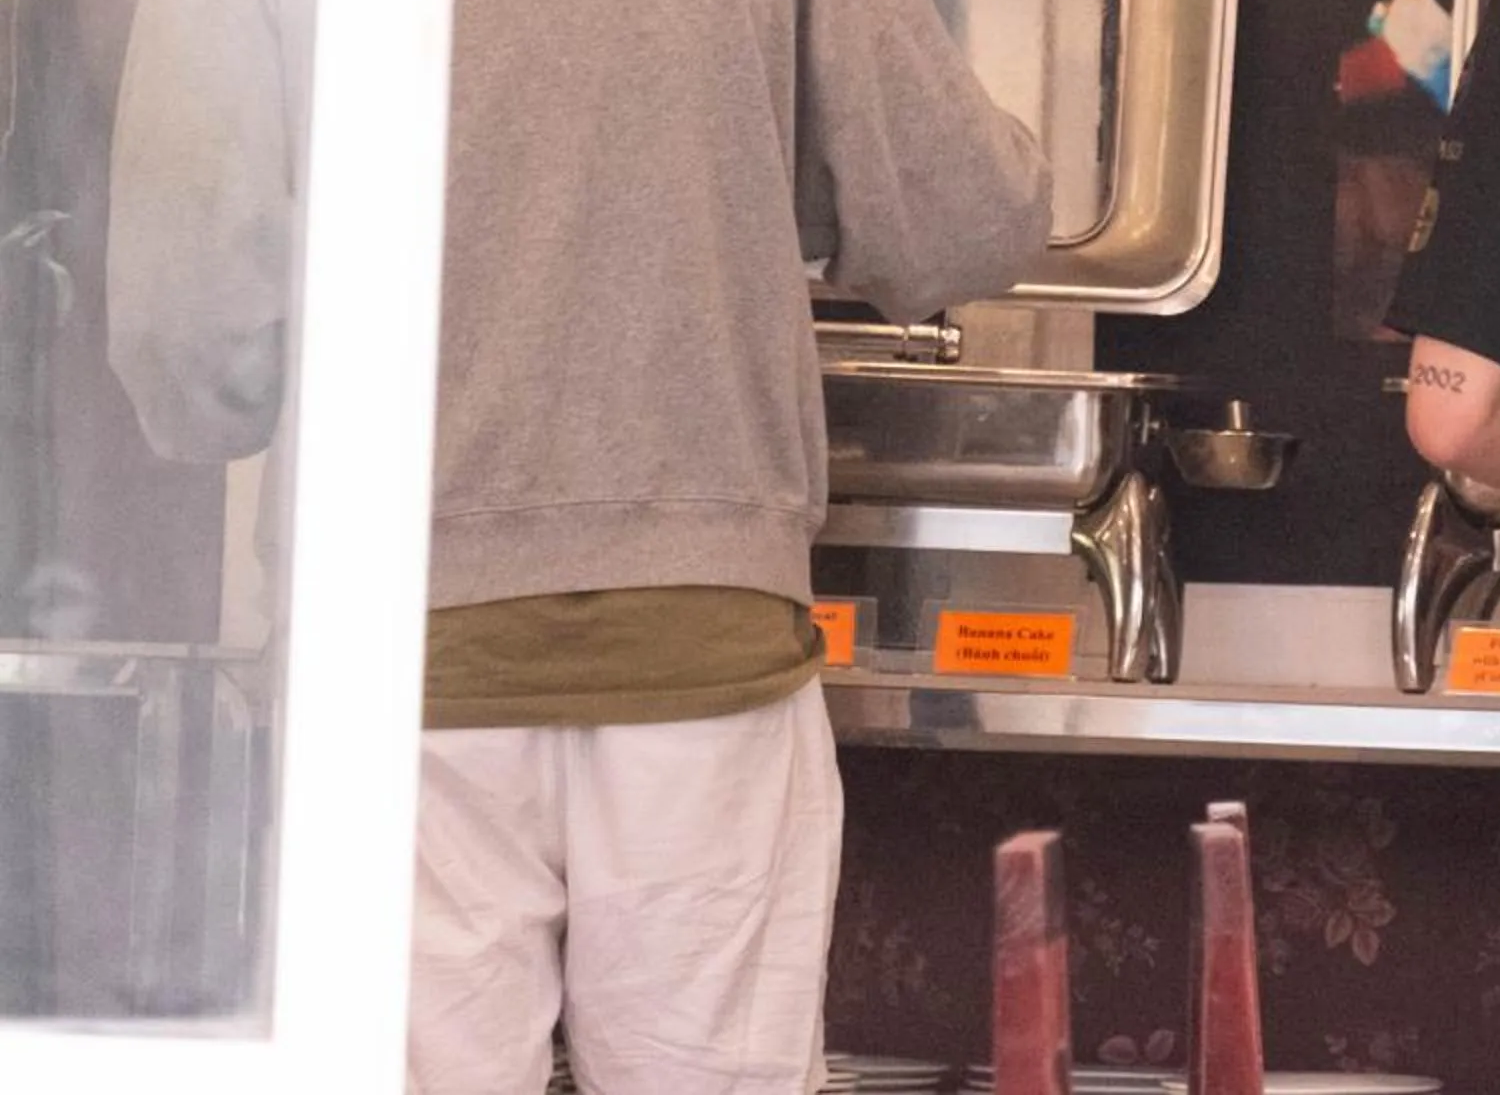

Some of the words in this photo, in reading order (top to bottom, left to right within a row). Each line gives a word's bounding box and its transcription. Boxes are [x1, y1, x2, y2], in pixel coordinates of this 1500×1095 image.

[1414, 363, 1466, 394] 2002
[958, 624, 1012, 640] Banana
[1017, 626, 1054, 641] Cake
